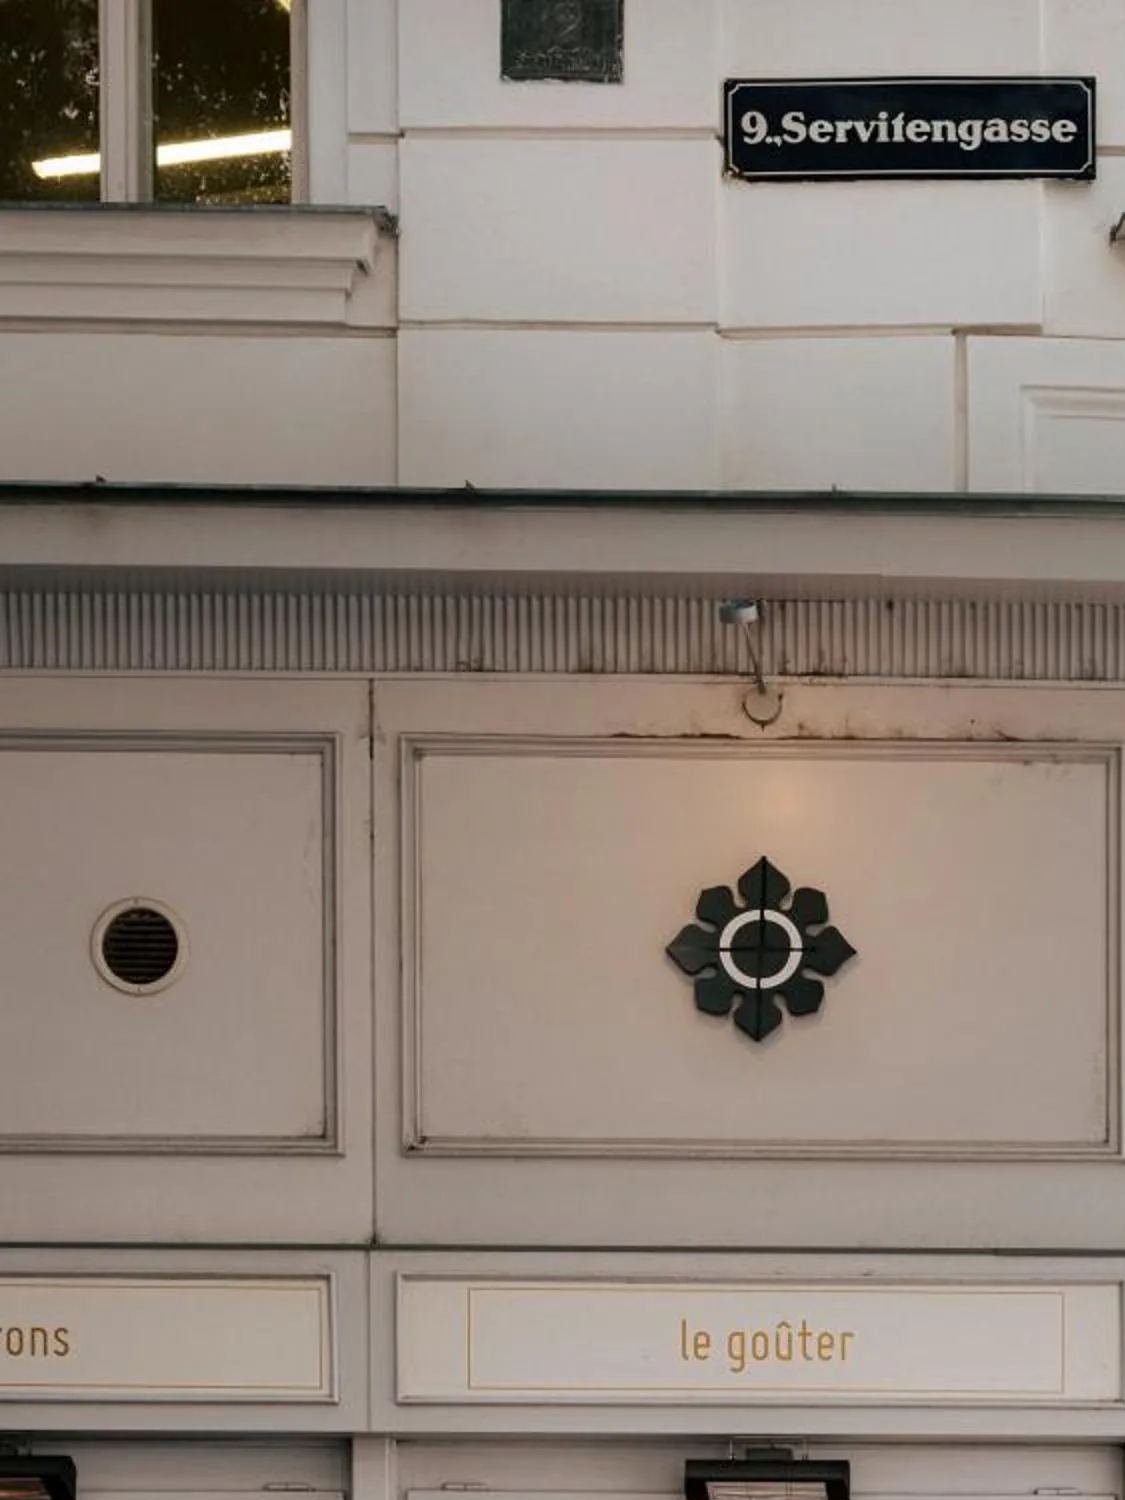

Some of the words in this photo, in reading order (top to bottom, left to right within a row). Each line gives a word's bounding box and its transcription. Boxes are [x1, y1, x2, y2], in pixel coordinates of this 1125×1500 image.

[0, 1326, 71, 1357] ons
[680, 1318, 712, 1362] le
[727, 1319, 855, 1374] goûter
